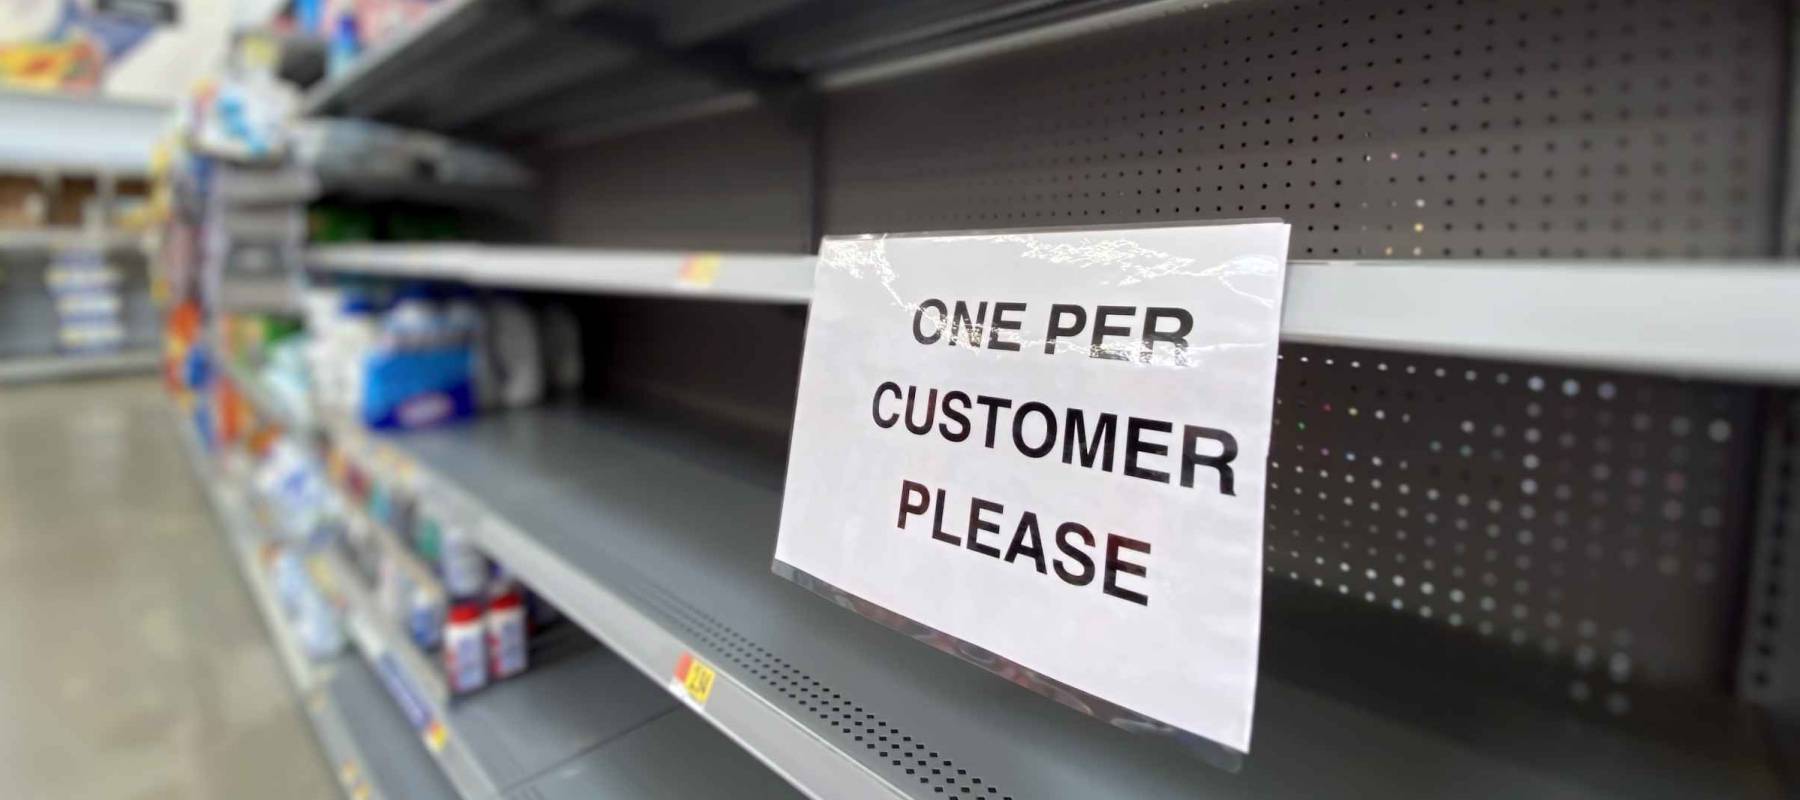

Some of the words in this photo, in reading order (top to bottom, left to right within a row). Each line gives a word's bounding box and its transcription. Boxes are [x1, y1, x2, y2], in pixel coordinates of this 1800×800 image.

[911, 298, 1027, 352] ONE
[1043, 303, 1195, 367] PER
[871, 381, 1239, 497] CUSTOMER
[896, 479, 1152, 607] PLEASE
